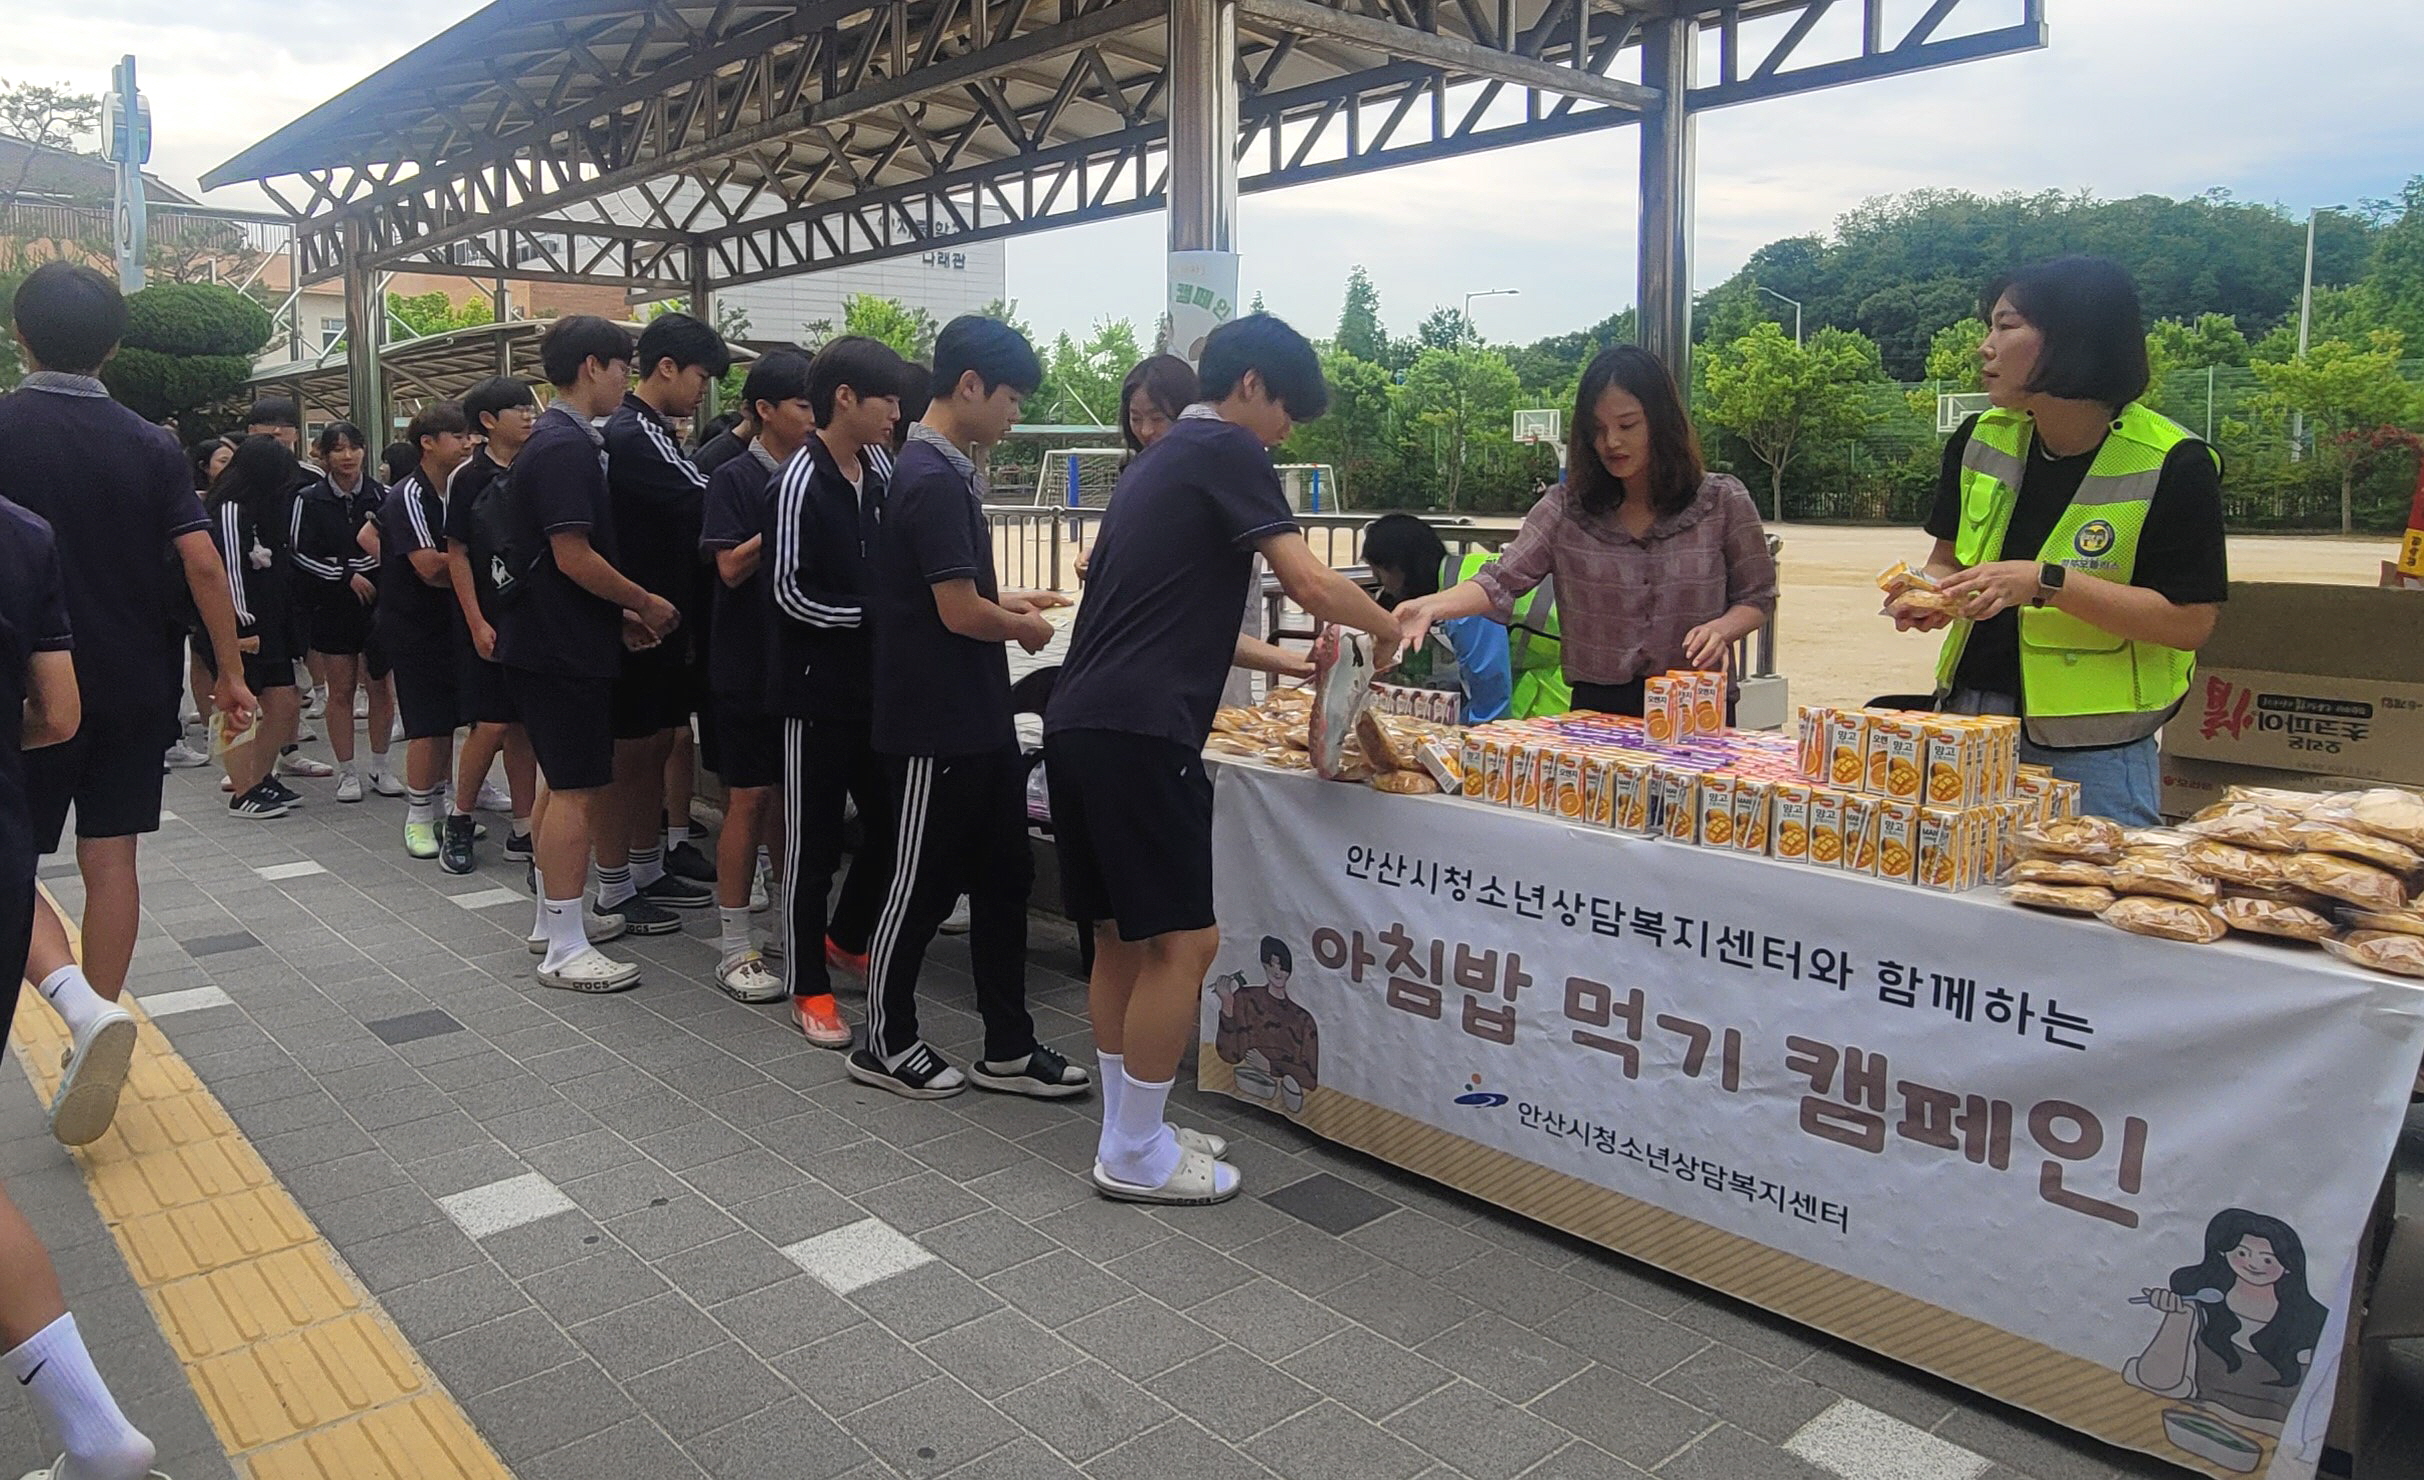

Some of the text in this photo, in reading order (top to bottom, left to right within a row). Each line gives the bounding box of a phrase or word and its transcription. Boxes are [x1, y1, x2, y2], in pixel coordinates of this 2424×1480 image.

[922, 252, 966, 269] 나래관
[2200, 675, 2254, 742] 情
[1837, 730, 1857, 741] 망고
[1873, 734, 1888, 745] 오렌
[1892, 740, 1913, 752] 망고
[1934, 745, 1956, 757] 망고
[2288, 735, 2344, 755] 오리온
[1708, 792, 1728, 803] 망고
[1783, 803, 1804, 814] 망고
[1815, 808, 1836, 819] 망고
[1884, 820, 1904, 832] 망고
[1346, 845, 2094, 1051] 안산시청소년상담복지센터와 함께하는
[1311, 922, 2148, 1229] 아침밥 먹기 캠페인
[1517, 1101, 1850, 1235] 안산시청소년상담복지센터
